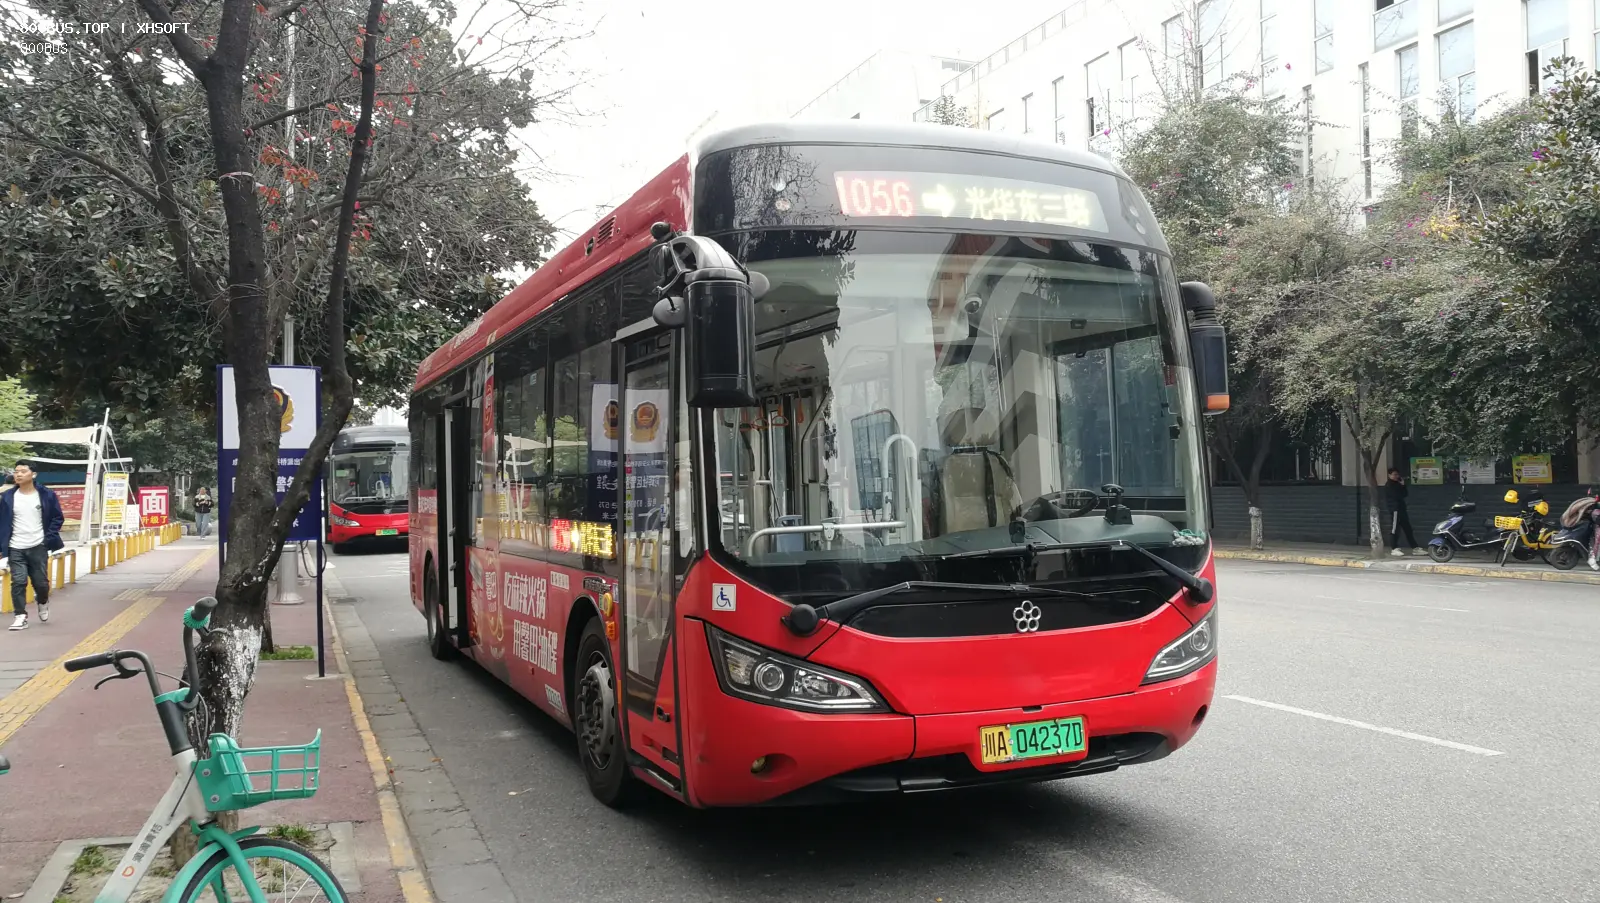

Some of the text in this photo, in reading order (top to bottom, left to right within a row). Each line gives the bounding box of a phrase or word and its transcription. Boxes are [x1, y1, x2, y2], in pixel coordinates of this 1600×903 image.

[835, 176, 1091, 226] 1056 光华东三路
[140, 489, 168, 516] 面
[503, 571, 547, 620] 吃麻辣火锅
[513, 618, 558, 676] 用馨田油碟
[985, 722, 1083, 757] 川A 04237D
